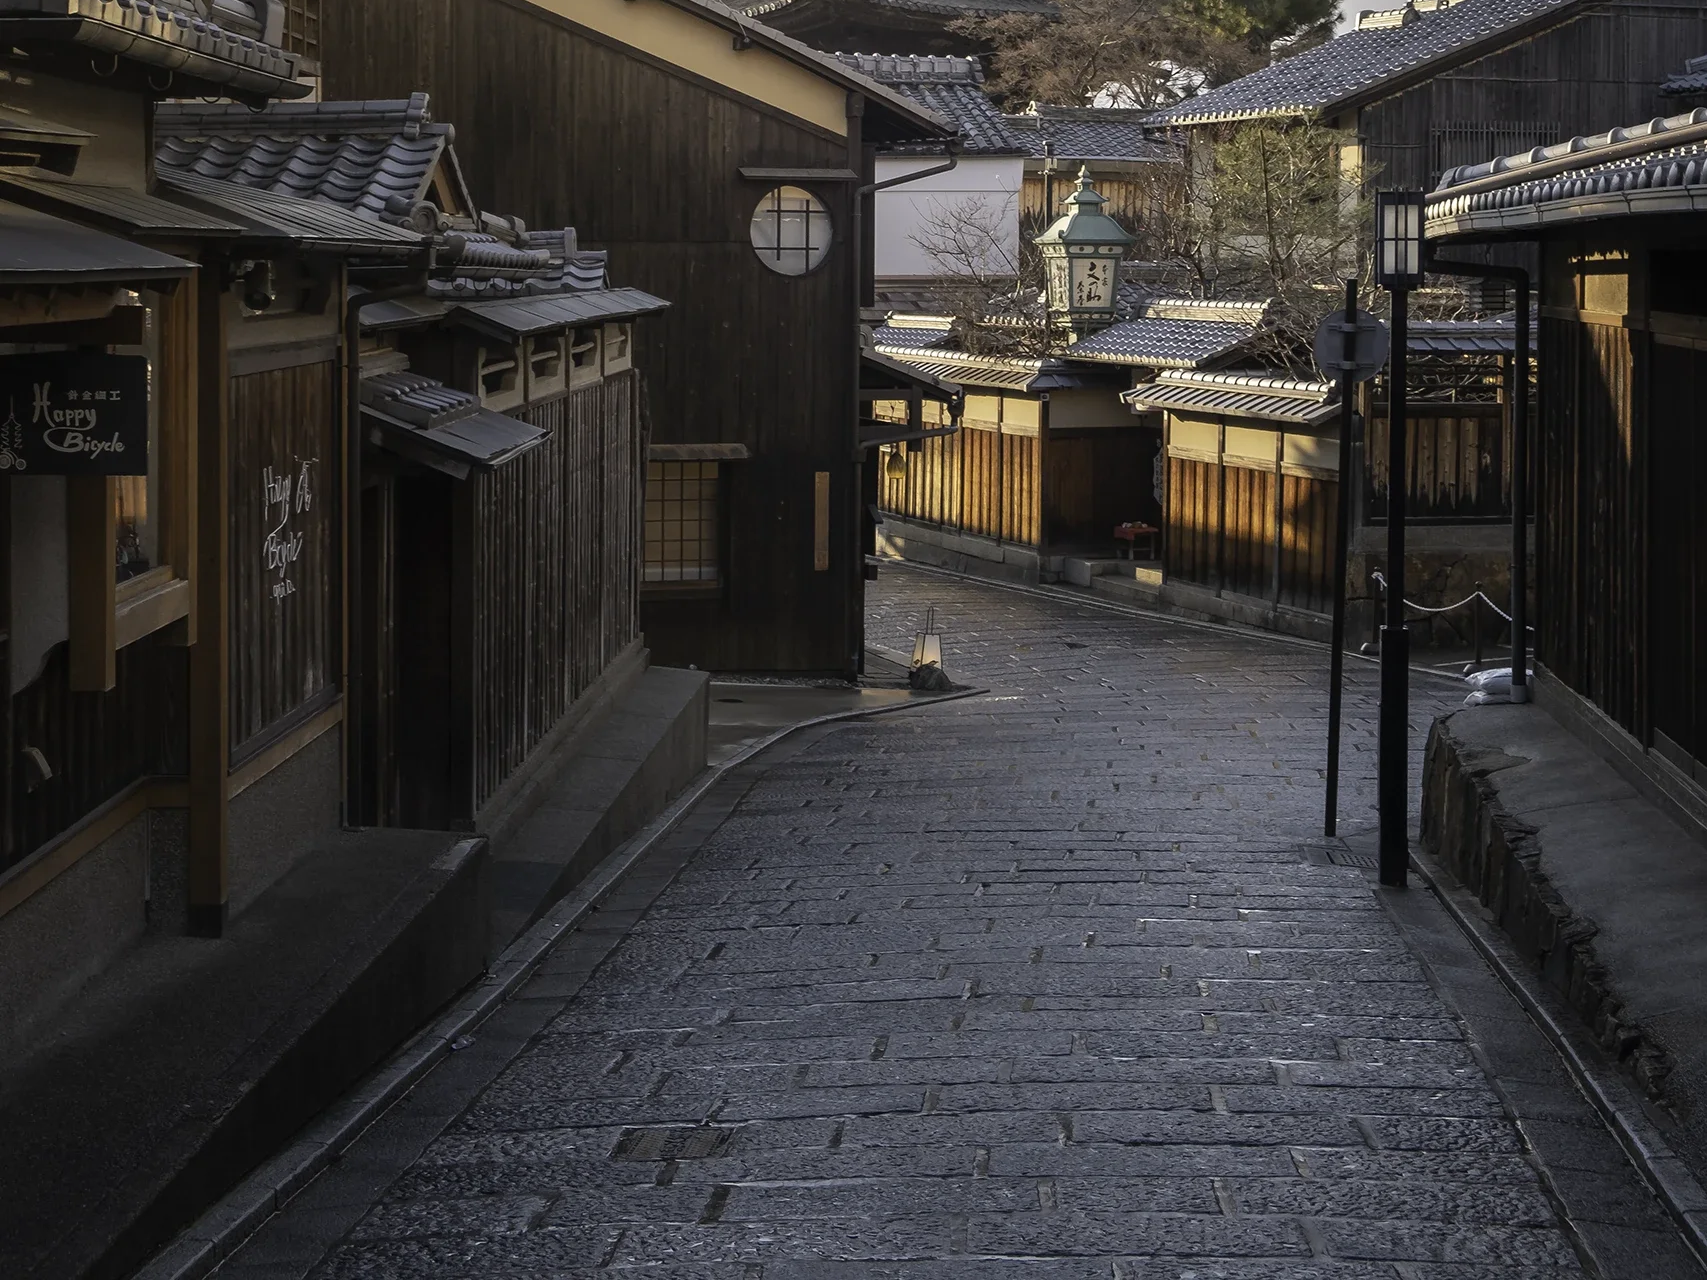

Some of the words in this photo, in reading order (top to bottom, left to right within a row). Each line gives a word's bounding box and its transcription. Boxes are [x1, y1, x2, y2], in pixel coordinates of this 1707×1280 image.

[32, 381, 97, 430] Happy
[66, 389, 121, 401] 針金細工
[62, 431, 126, 460] Bicycle
